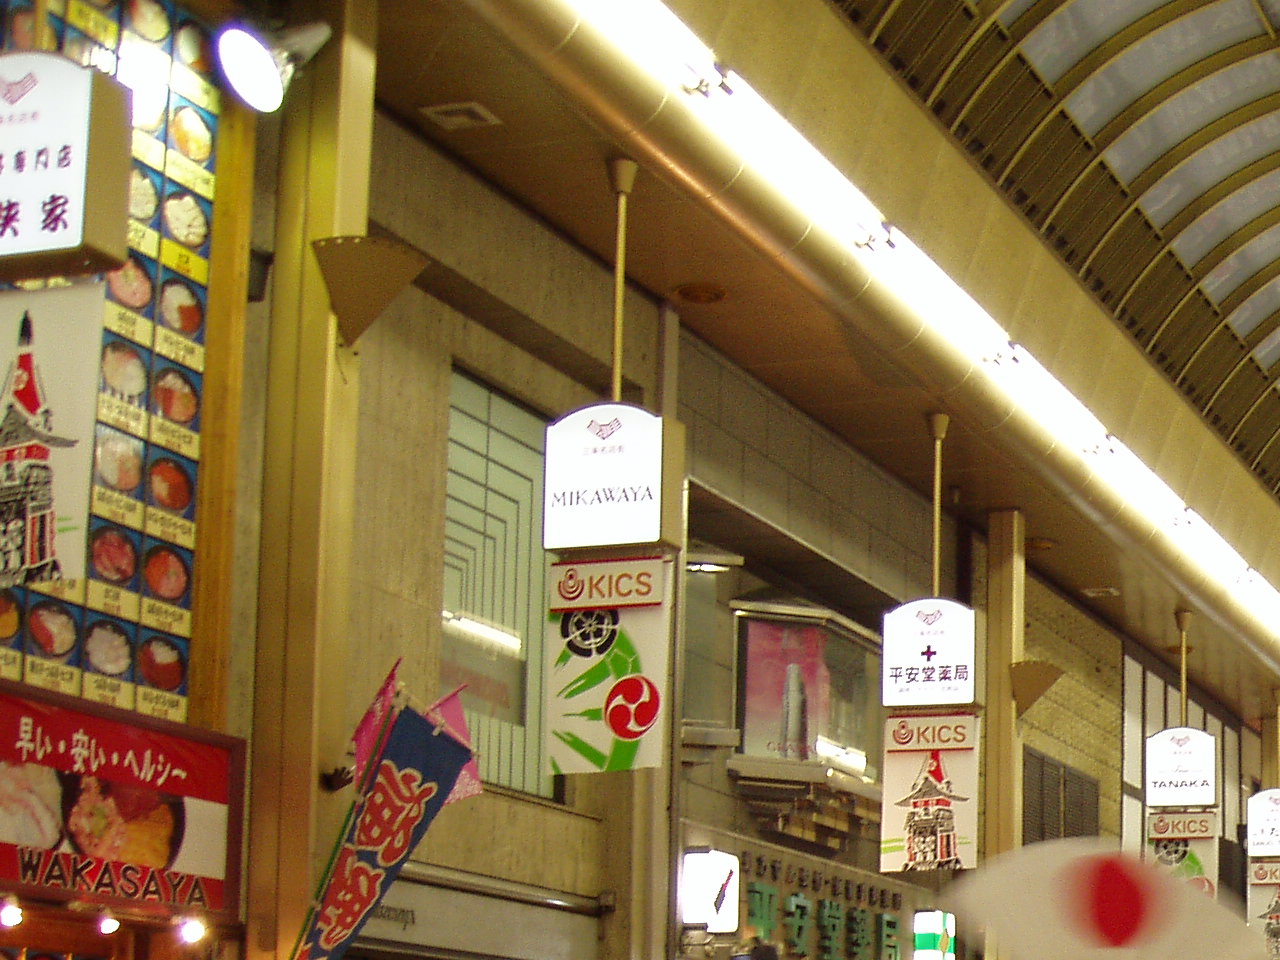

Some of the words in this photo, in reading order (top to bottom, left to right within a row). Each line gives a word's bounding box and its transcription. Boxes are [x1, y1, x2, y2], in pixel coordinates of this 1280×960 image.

[0, 144, 72, 175] 専門店
[551, 485, 654, 508] MIKAWAYA
[588, 572, 653, 599] KICS
[889, 664, 969, 685] 平安堂薬局
[917, 725, 967, 745] KICS
[15, 716, 188, 788] 早い・安い・ヘルシー
[1151, 780, 1210, 789] TANAKA
[1171, 819, 1210, 834] KICS
[16, 847, 208, 911] WAKASAYA
